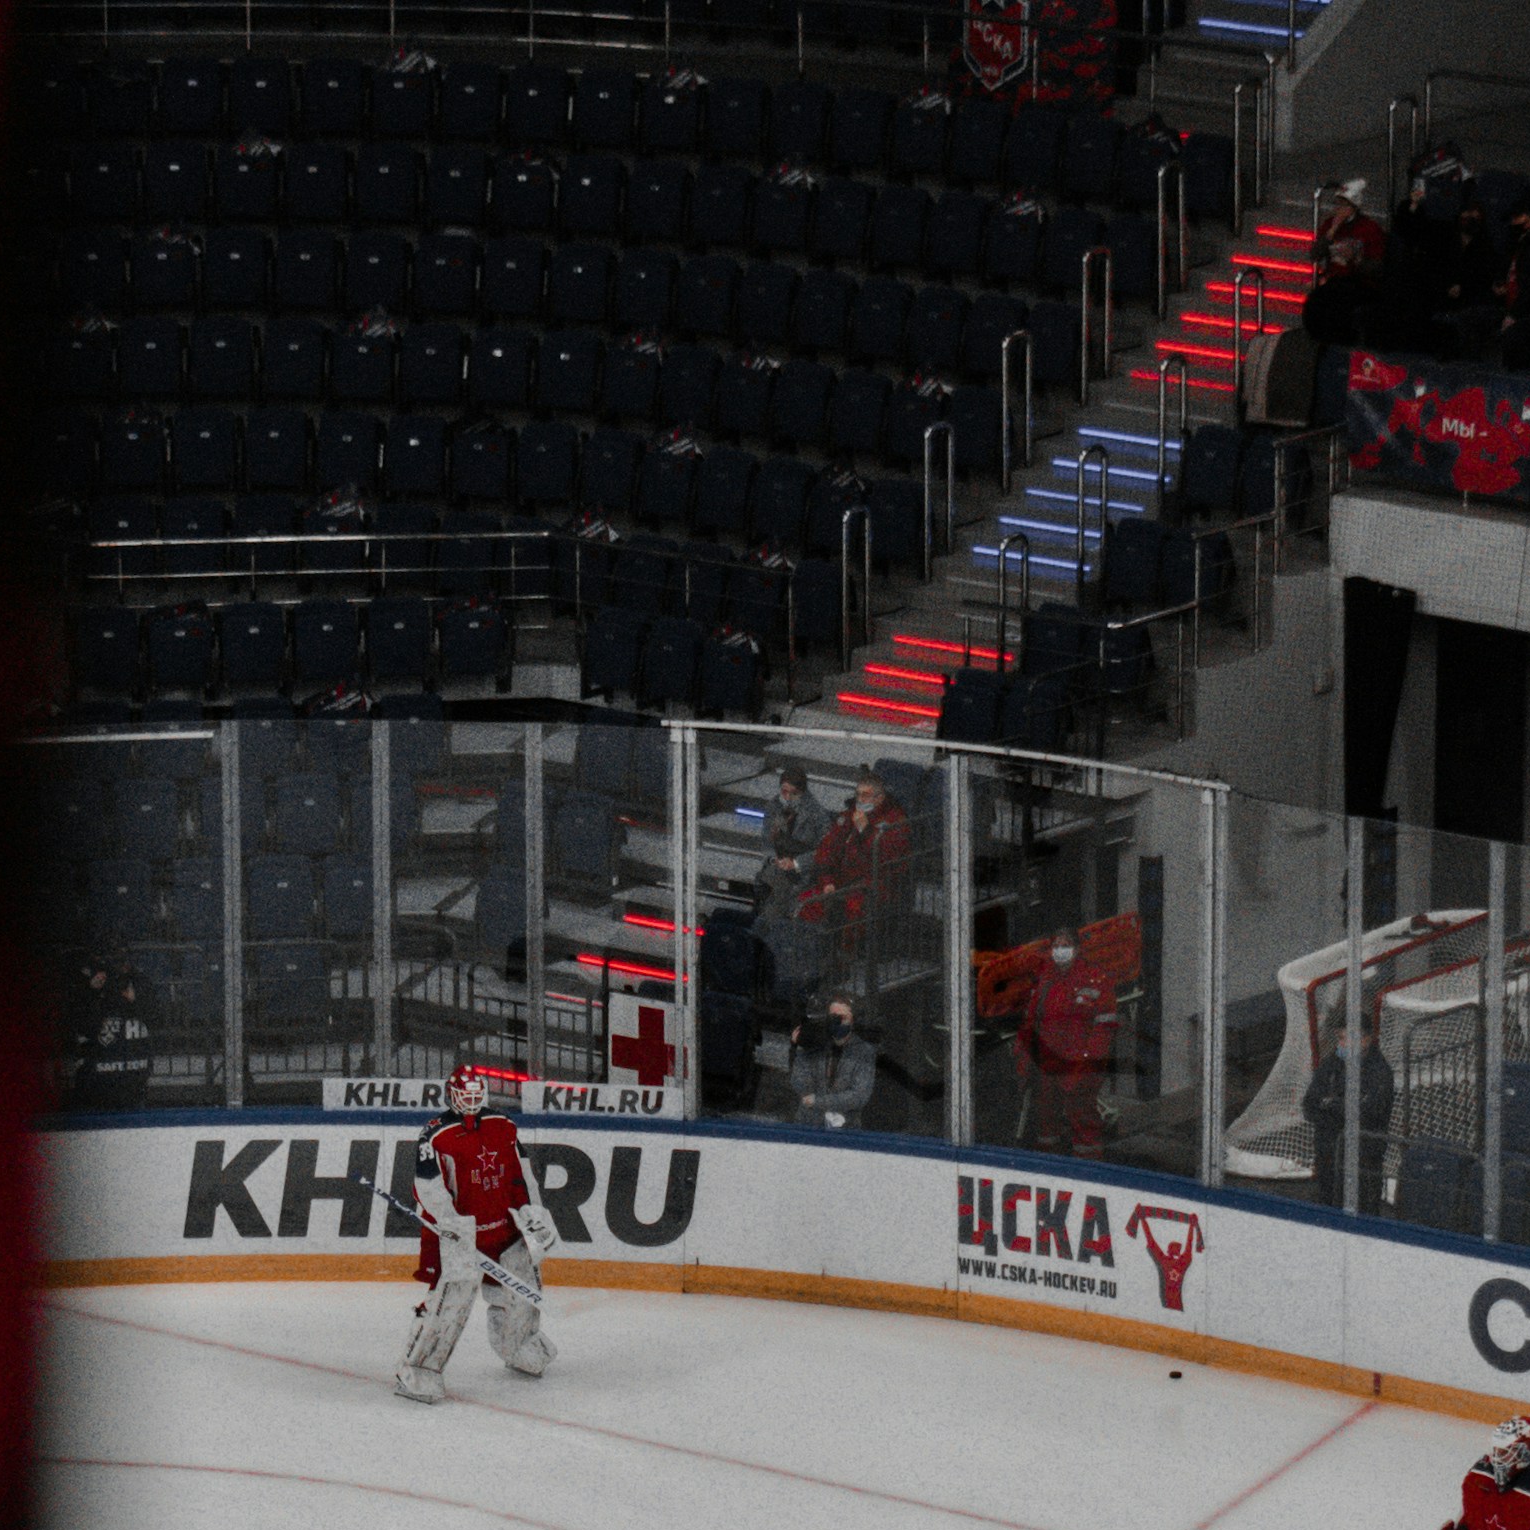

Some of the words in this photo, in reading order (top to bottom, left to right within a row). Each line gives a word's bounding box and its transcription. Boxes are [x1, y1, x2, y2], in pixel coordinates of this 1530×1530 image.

[1441, 416, 1475, 441] МЫ
[343, 1082, 451, 1109] KHL.R
[542, 1085, 665, 1115] KHL.RU
[183, 1138, 701, 1247] KHLRU
[957, 1174, 1115, 1268] ЦСКА
